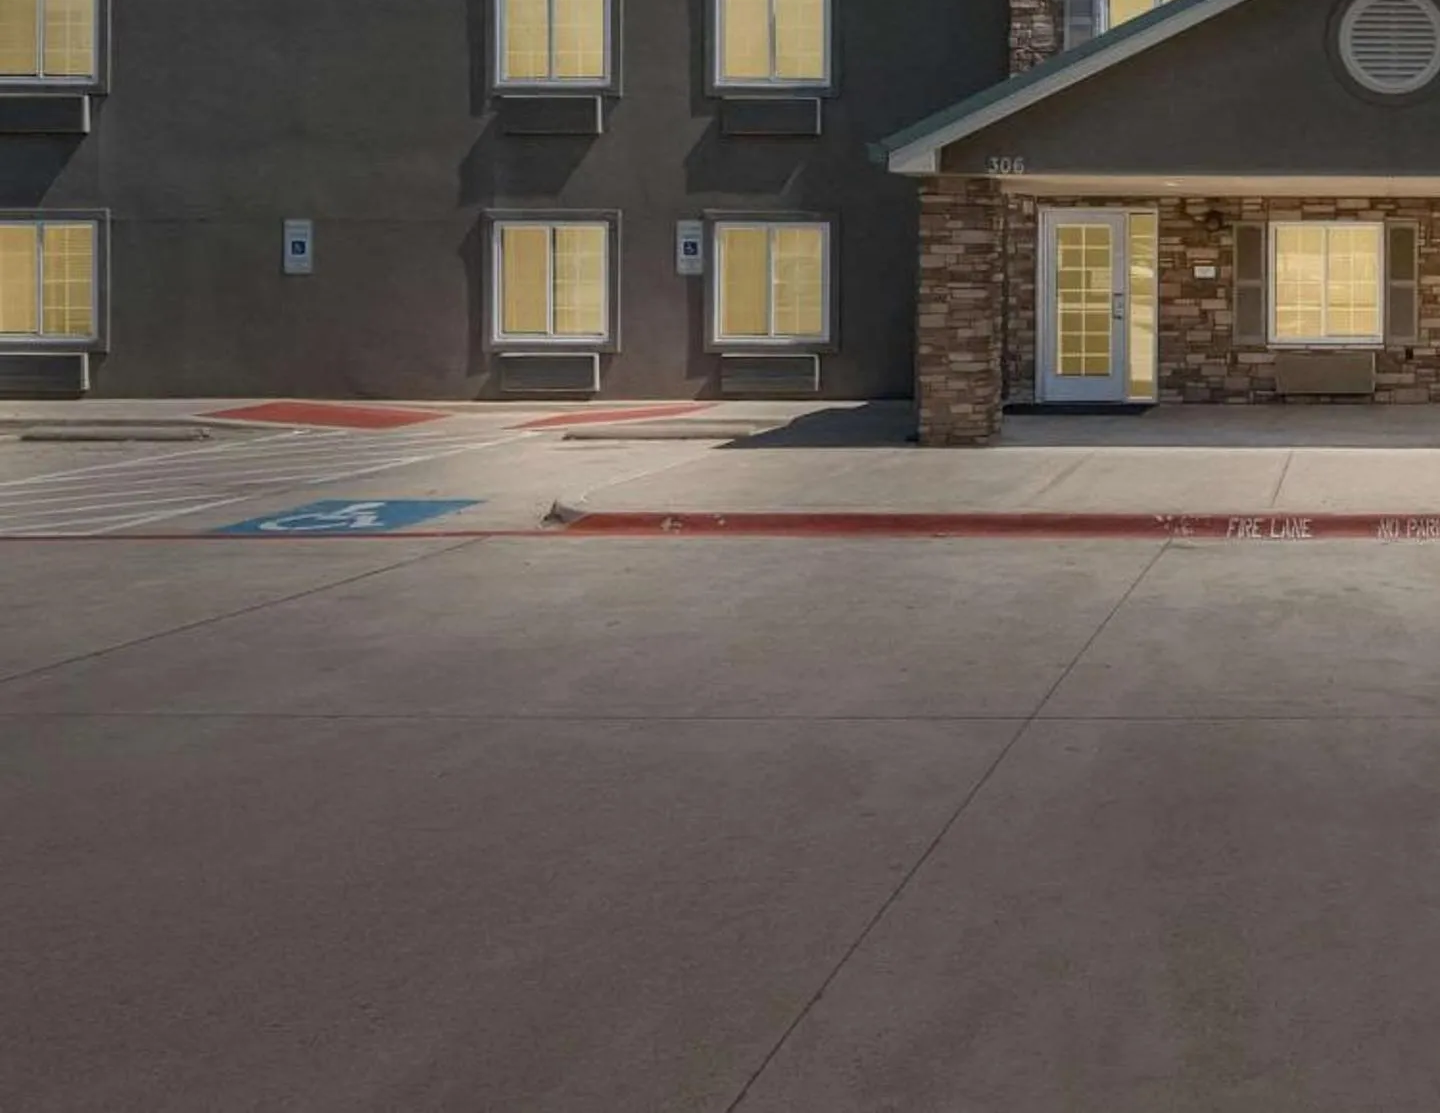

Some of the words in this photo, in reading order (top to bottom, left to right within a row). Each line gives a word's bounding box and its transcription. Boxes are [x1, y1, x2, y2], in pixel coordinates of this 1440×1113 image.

[988, 156, 1025, 175] 306
[1226, 517, 1263, 538] FIRE
[1270, 517, 1313, 538] LANE
[1377, 517, 1399, 539] NO
